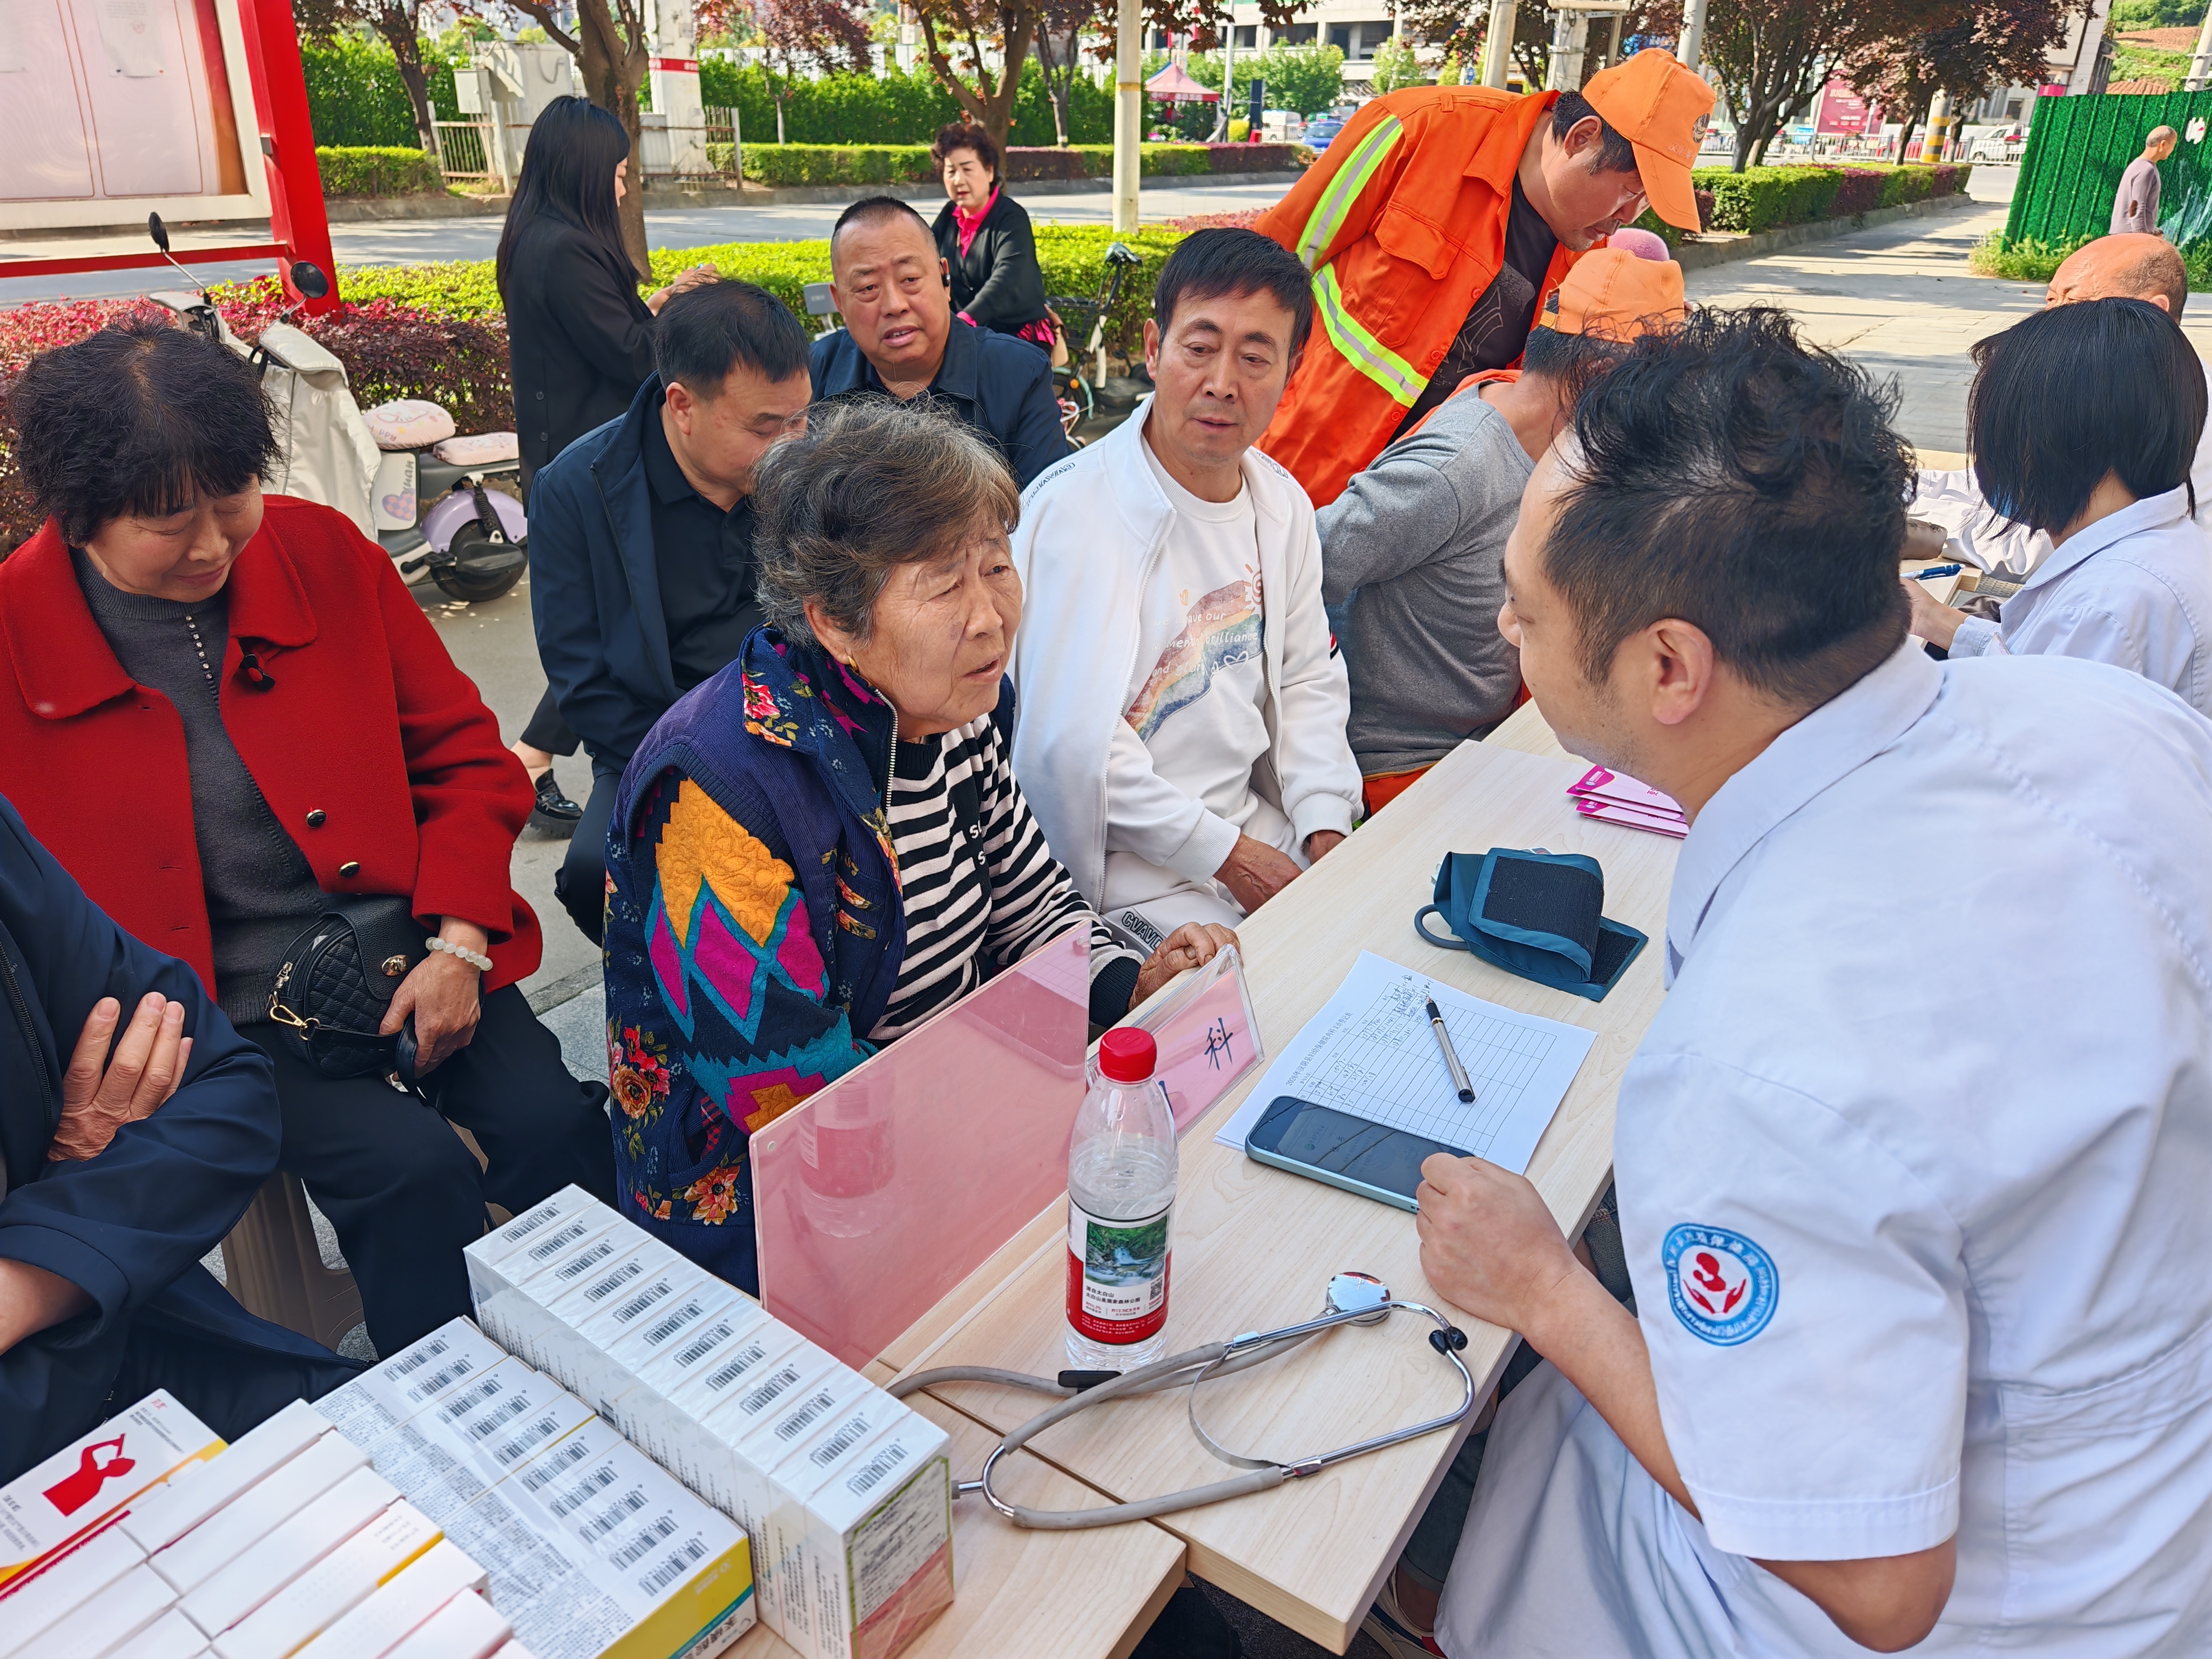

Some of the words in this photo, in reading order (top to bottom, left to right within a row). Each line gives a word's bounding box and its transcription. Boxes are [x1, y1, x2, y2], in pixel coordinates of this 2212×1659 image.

[1205, 612, 1227, 622] our
[1205, 630, 1258, 645] brilliance
[1151, 662, 1170, 678] and
[1204, 1017, 1233, 1071] 科
